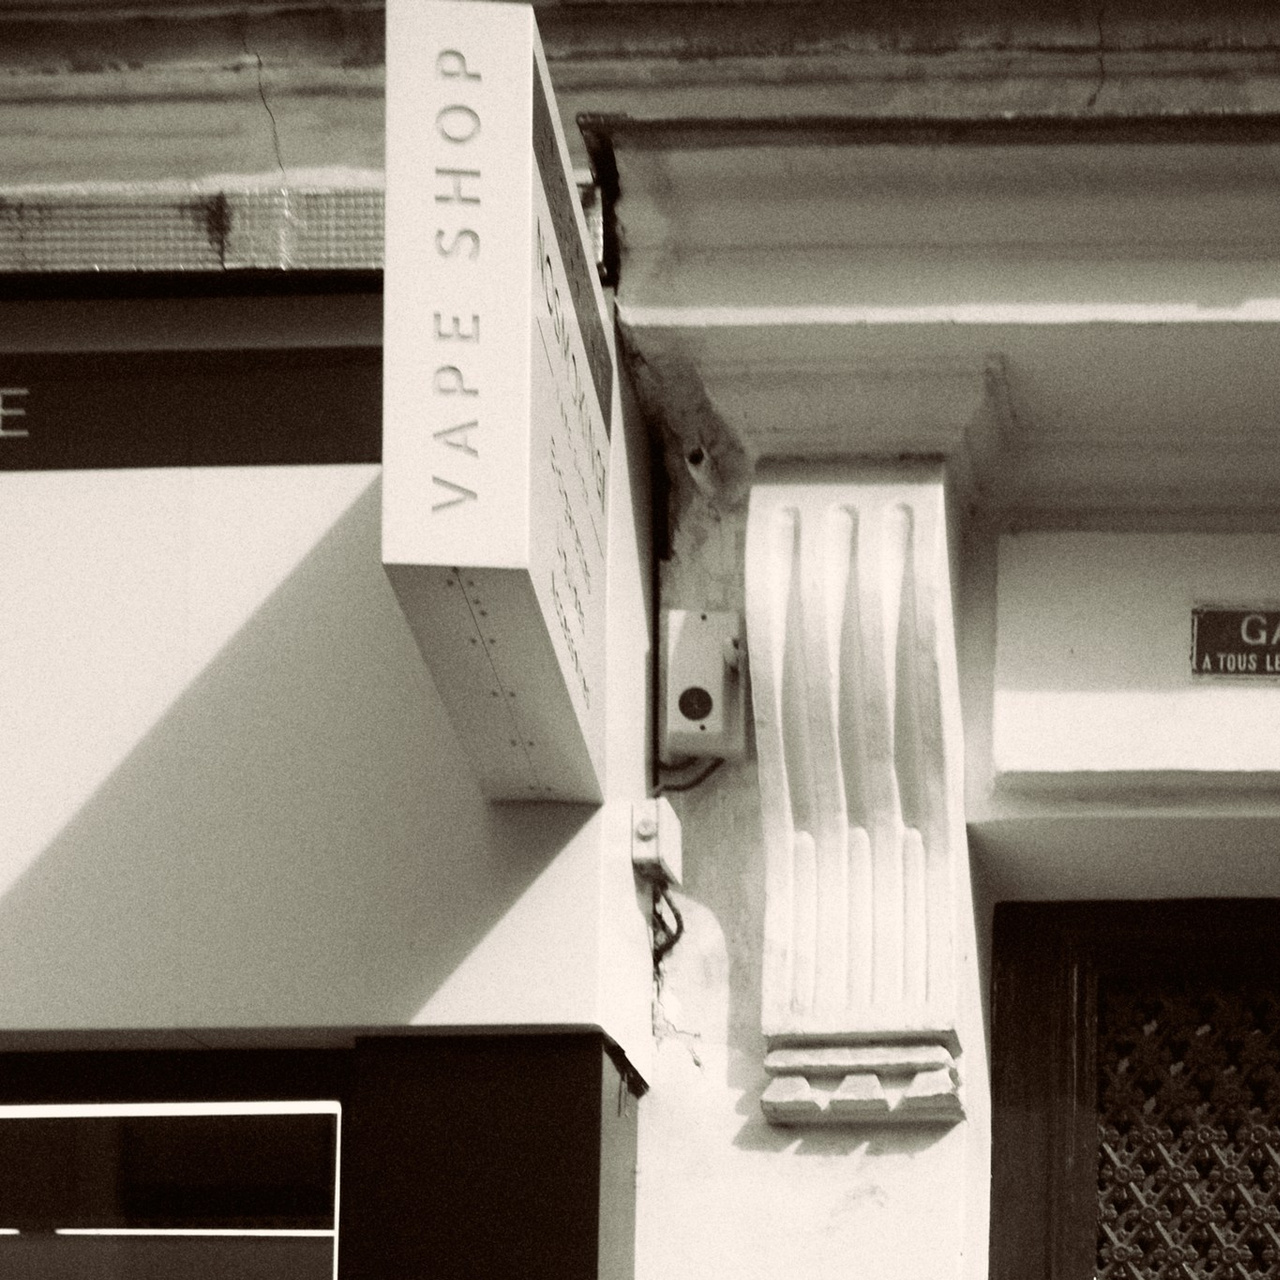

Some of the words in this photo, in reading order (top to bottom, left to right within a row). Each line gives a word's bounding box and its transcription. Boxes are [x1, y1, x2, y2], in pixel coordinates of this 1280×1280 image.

[434, 49, 482, 262] SHOP
[432, 312, 480, 512] VAPE
[1217, 652, 1258, 672] TOUS
